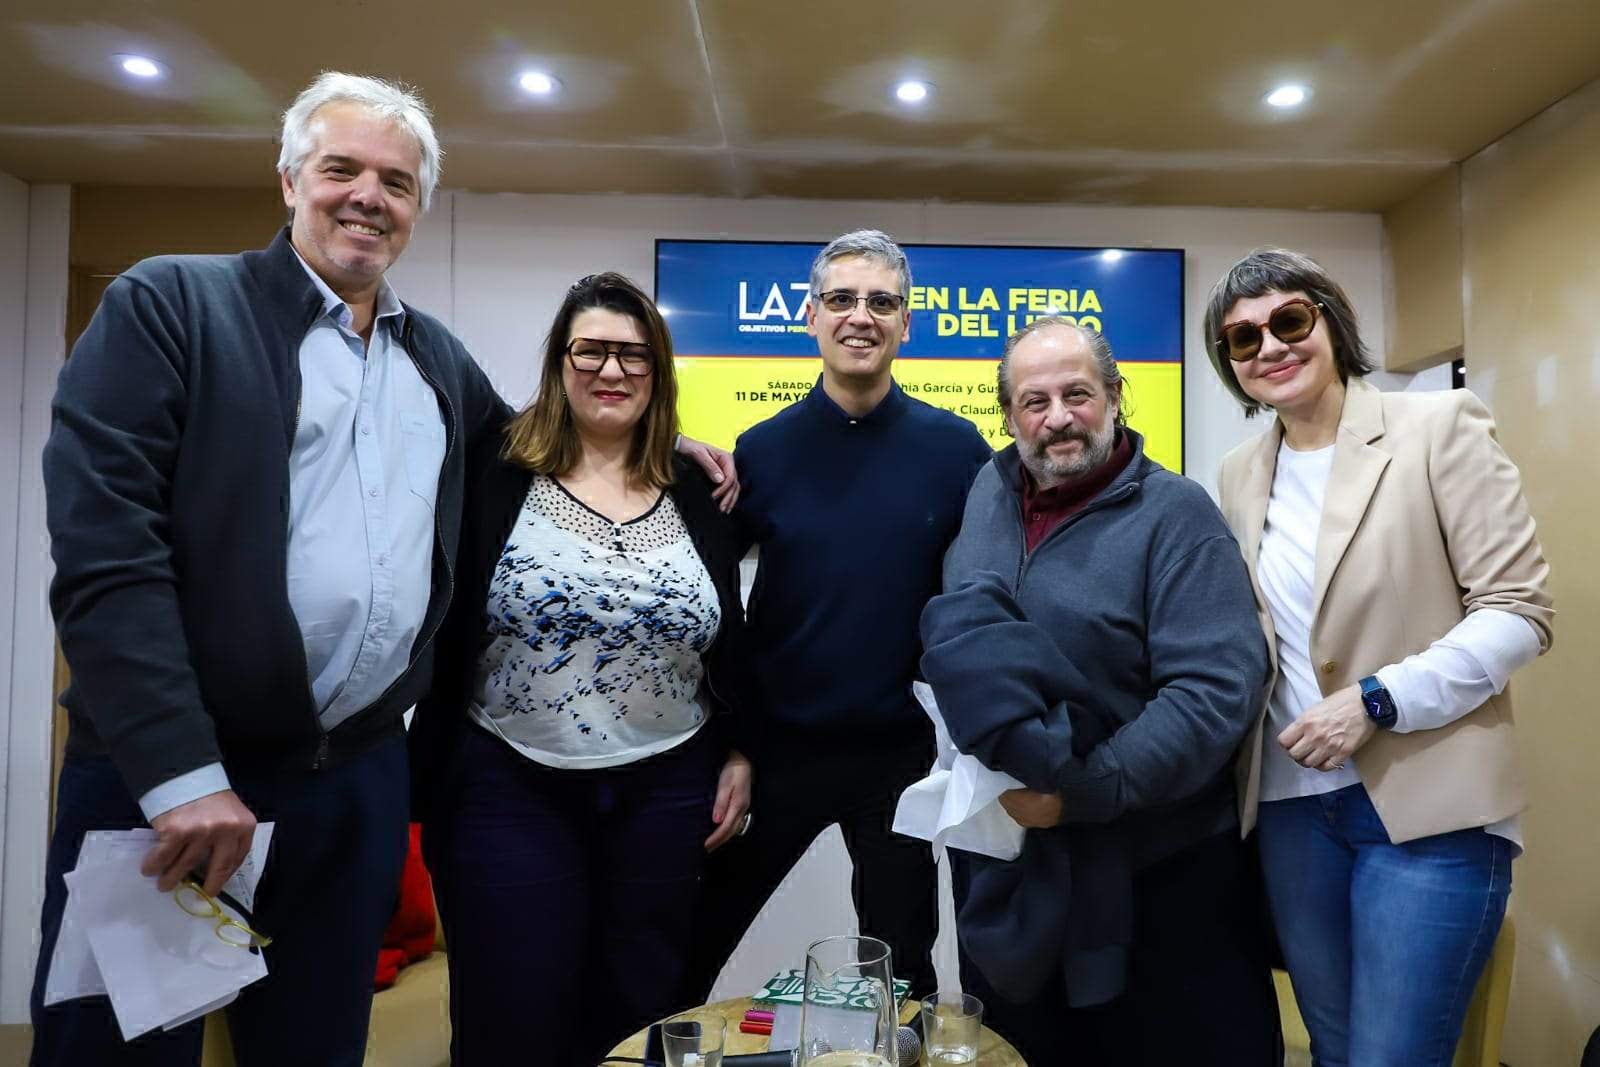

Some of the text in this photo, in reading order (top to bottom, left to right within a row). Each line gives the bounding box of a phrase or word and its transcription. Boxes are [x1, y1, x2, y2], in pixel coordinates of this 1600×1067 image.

[908, 287, 1102, 312] EN LA FERIA
[739, 325, 786, 333] OBJETIVOS
[937, 313, 999, 337] DEL
[923, 382, 963, 393] García
[967, 386, 974, 395] y
[735, 391, 746, 401] 11
[750, 391, 768, 402] DE
